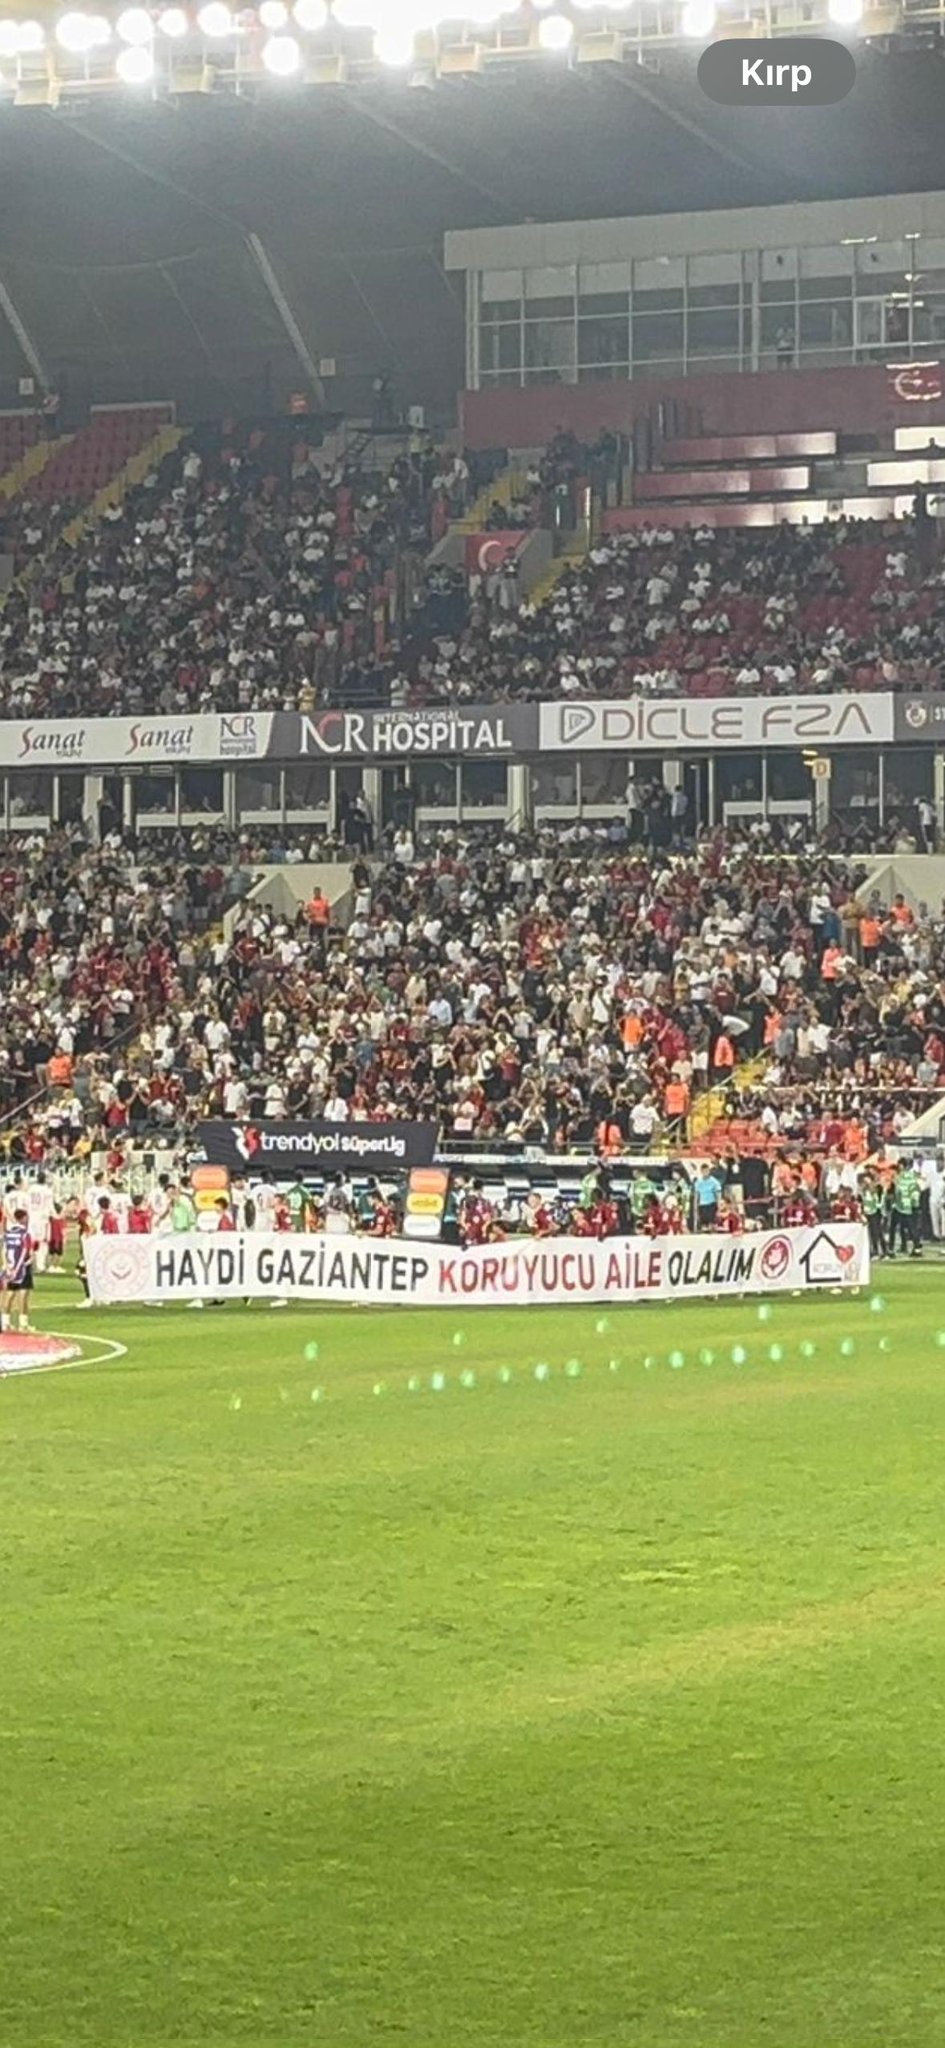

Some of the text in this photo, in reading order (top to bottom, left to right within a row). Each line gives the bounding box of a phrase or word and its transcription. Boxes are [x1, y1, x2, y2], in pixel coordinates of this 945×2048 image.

[220, 715, 256, 737] NCR
[299, 710, 512, 754] NCR HOSPITAL
[602, 701, 743, 742] DİCLE
[18, 726, 86, 758] Sanat
[125, 723, 194, 755] Sanat
[816, 761, 828, 776] D
[260, 1131, 339, 1154] trendyol
[155, 1238, 244, 1288] HAYDİ
[256, 1241, 429, 1293] GAZİANTEP
[438, 1253, 595, 1293] KORUYUCU
[604, 1242, 662, 1289] AİLE
[667, 1247, 756, 1287] OLALIM
